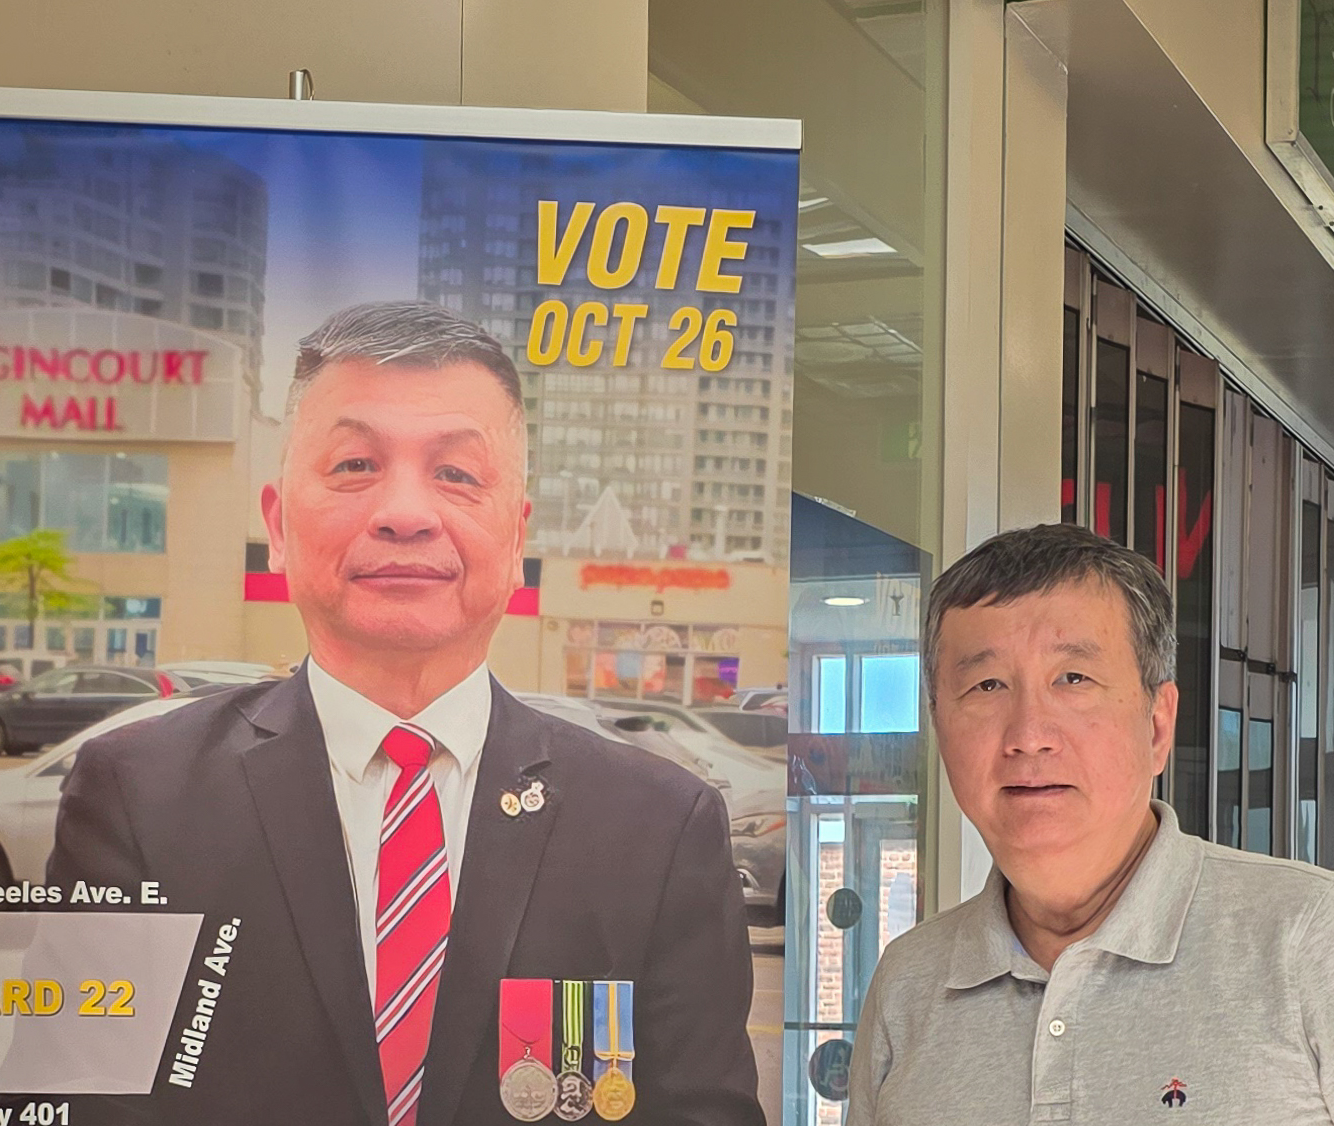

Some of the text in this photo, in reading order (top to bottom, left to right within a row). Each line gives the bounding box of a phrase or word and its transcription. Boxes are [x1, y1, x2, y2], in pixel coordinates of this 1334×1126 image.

[537, 200, 756, 294] VOTE
[526, 299, 738, 373] OCT 26
[20, 393, 124, 433] MALL
[71, 880, 132, 905] Ave.
[141, 881, 169, 905] E.
[77, 977, 136, 1017] 22
[168, 917, 243, 1089] Midland Ave.
[18, 1102, 71, 1126] 401
